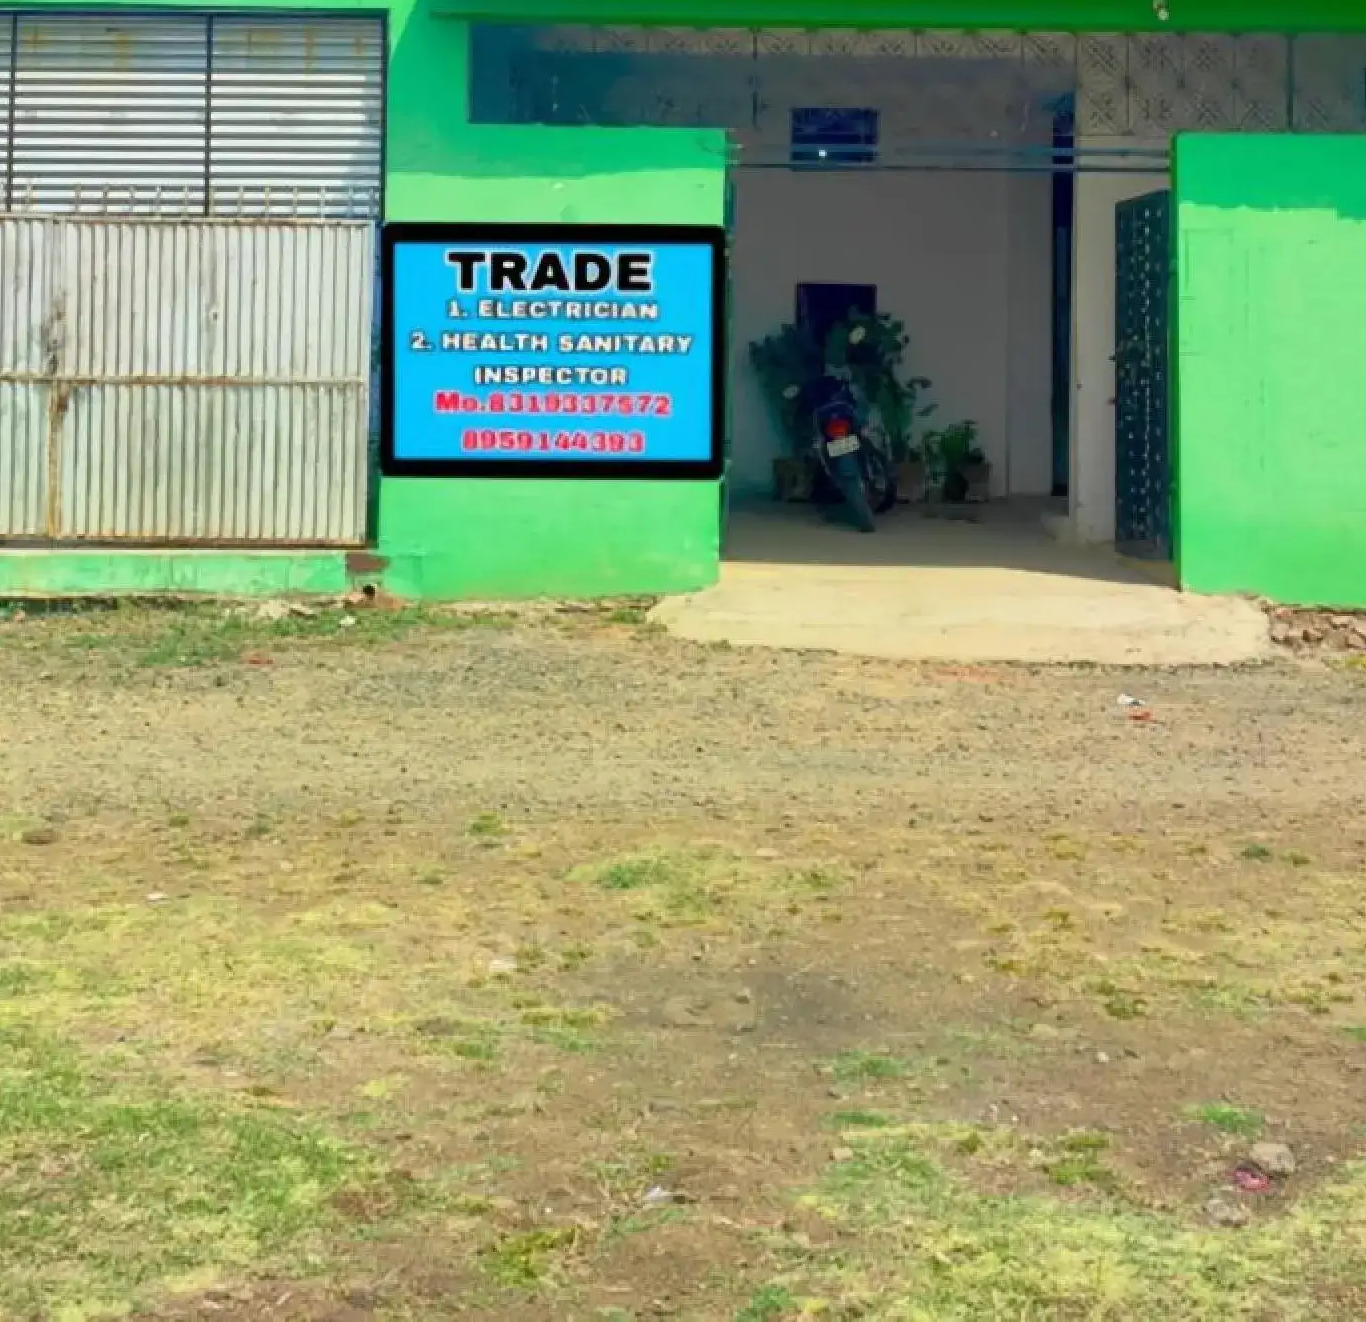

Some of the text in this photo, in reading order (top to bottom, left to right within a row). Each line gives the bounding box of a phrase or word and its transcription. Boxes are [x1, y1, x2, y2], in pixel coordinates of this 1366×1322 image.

[447, 251, 654, 292] TRADE
[448, 299, 658, 320] 1. ELECTRICIAN
[410, 331, 692, 354] 2. HEALTH SANITARY
[473, 366, 627, 385] INSPECTOR
